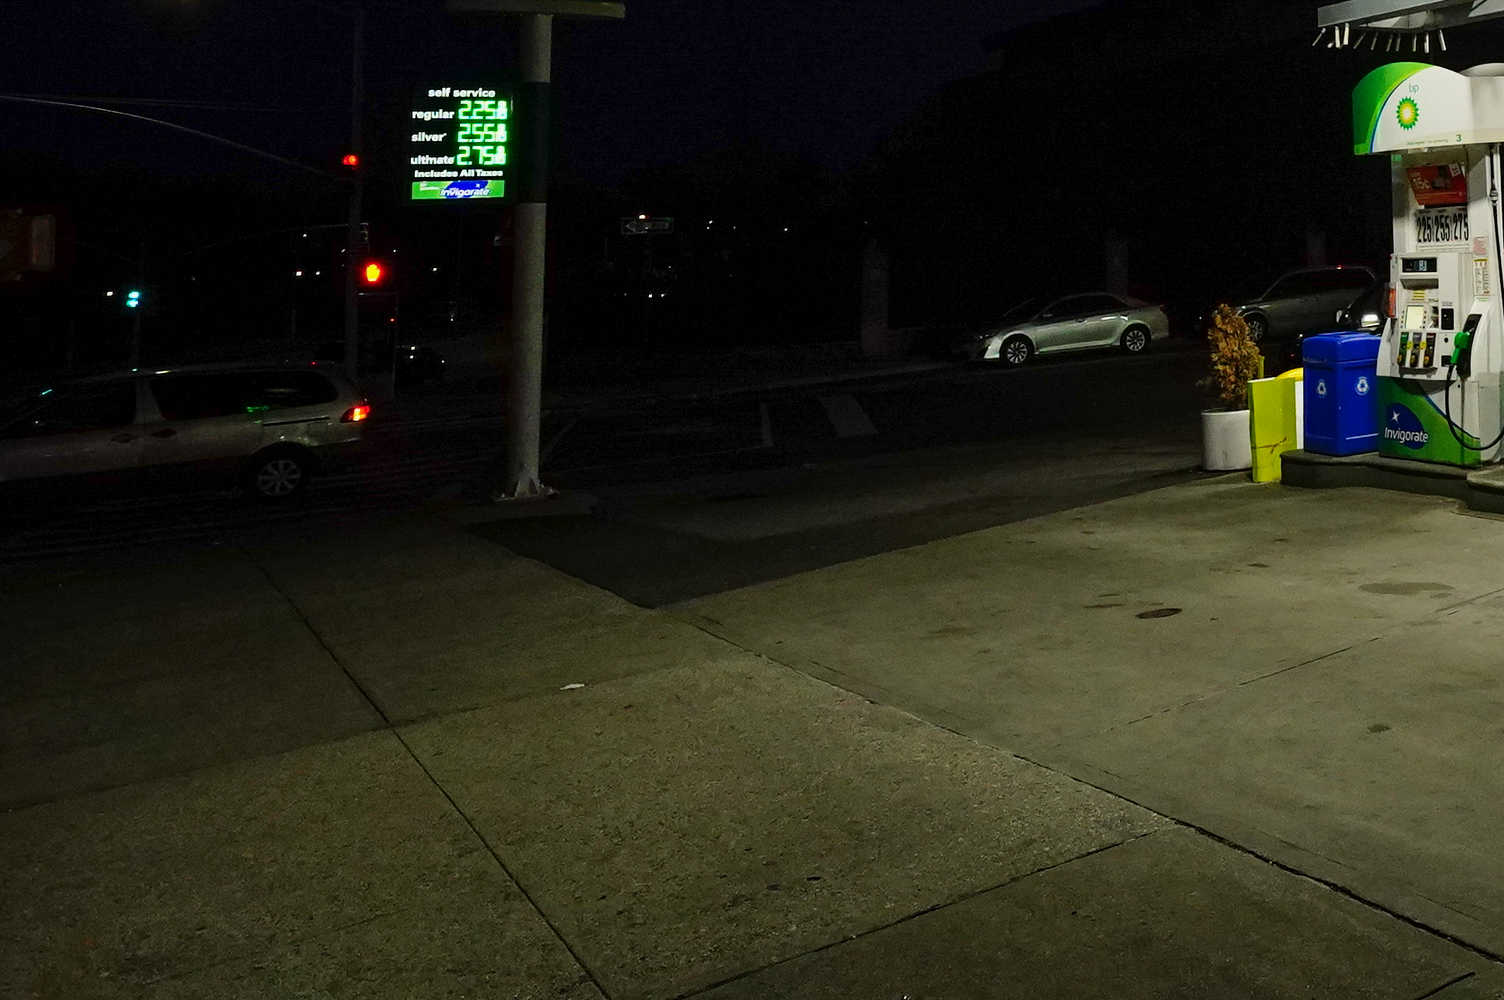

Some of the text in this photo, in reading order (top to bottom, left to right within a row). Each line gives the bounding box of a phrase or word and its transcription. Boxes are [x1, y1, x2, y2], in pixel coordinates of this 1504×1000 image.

[428, 87, 496, 98] self service
[1409, 83, 1419, 93] bp
[412, 109, 455, 121] regular
[411, 132, 446, 142] silver
[1456, 134, 1462, 142] 3
[410, 155, 454, 165] ultimate
[414, 169, 504, 178] Includes All Taxes
[1384, 427, 1429, 443] Invigorate
